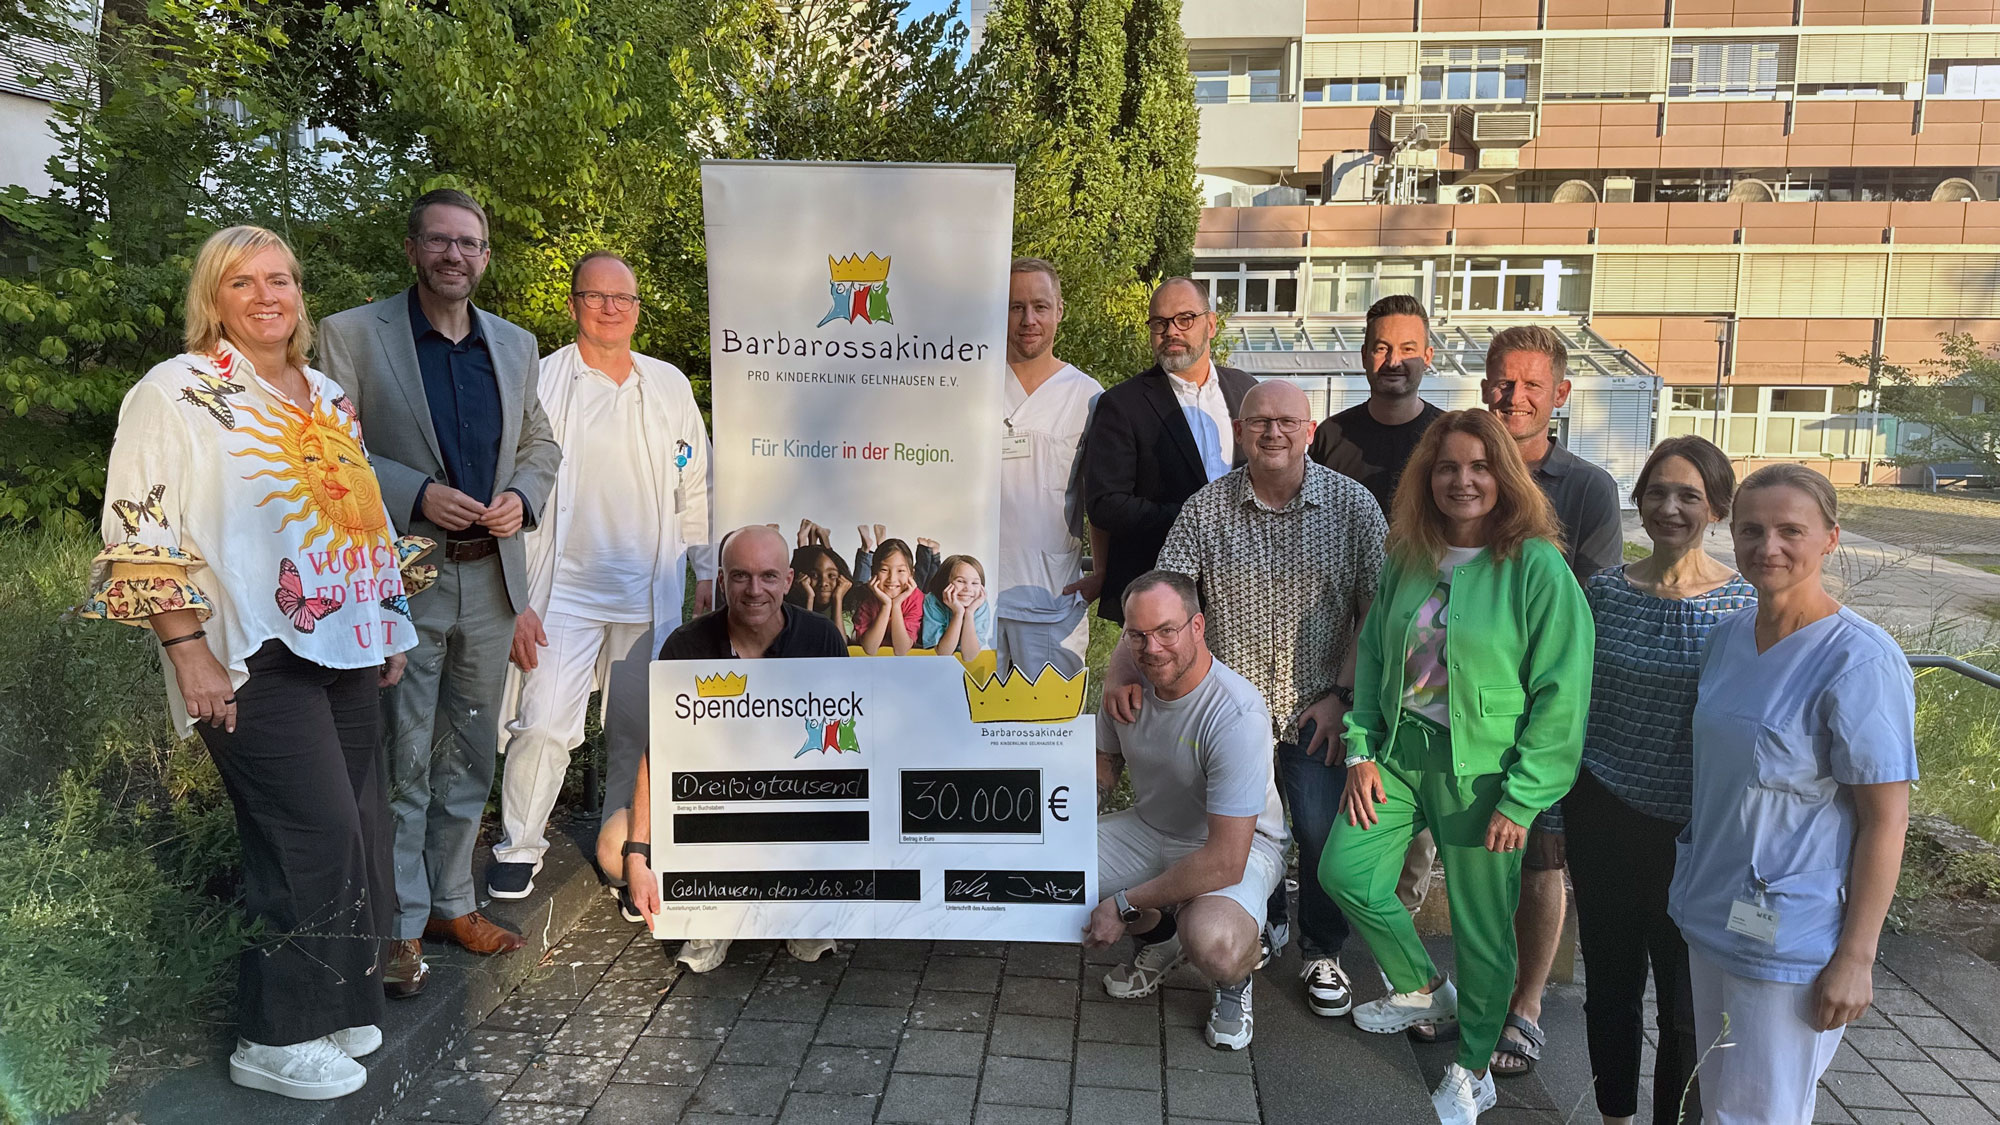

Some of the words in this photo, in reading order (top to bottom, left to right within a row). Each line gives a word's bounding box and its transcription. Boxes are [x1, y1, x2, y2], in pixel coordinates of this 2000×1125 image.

[721, 328, 989, 362] Barbarossakinder
[747, 370, 770, 382] PRO
[776, 371, 856, 384] KINDERKLINIK
[861, 374, 935, 387] GELNHAUSEN
[940, 376, 959, 388] E.V.
[751, 438, 778, 457] Für
[784, 438, 838, 459] Kinder
[843, 441, 857, 459] in
[862, 441, 889, 460] der
[894, 443, 954, 466] Region.
[674, 691, 864, 725] Spendenscheck
[981, 727, 1074, 738] Barbarossakinder
[676, 772, 863, 800] Dreißigtausend
[907, 780, 1035, 823] 30.000
[1047, 785, 1070, 822] €
[902, 835, 918, 843] Betrag
[671, 878, 763, 900] Gelnhausen,
[767, 880, 799, 899] den
